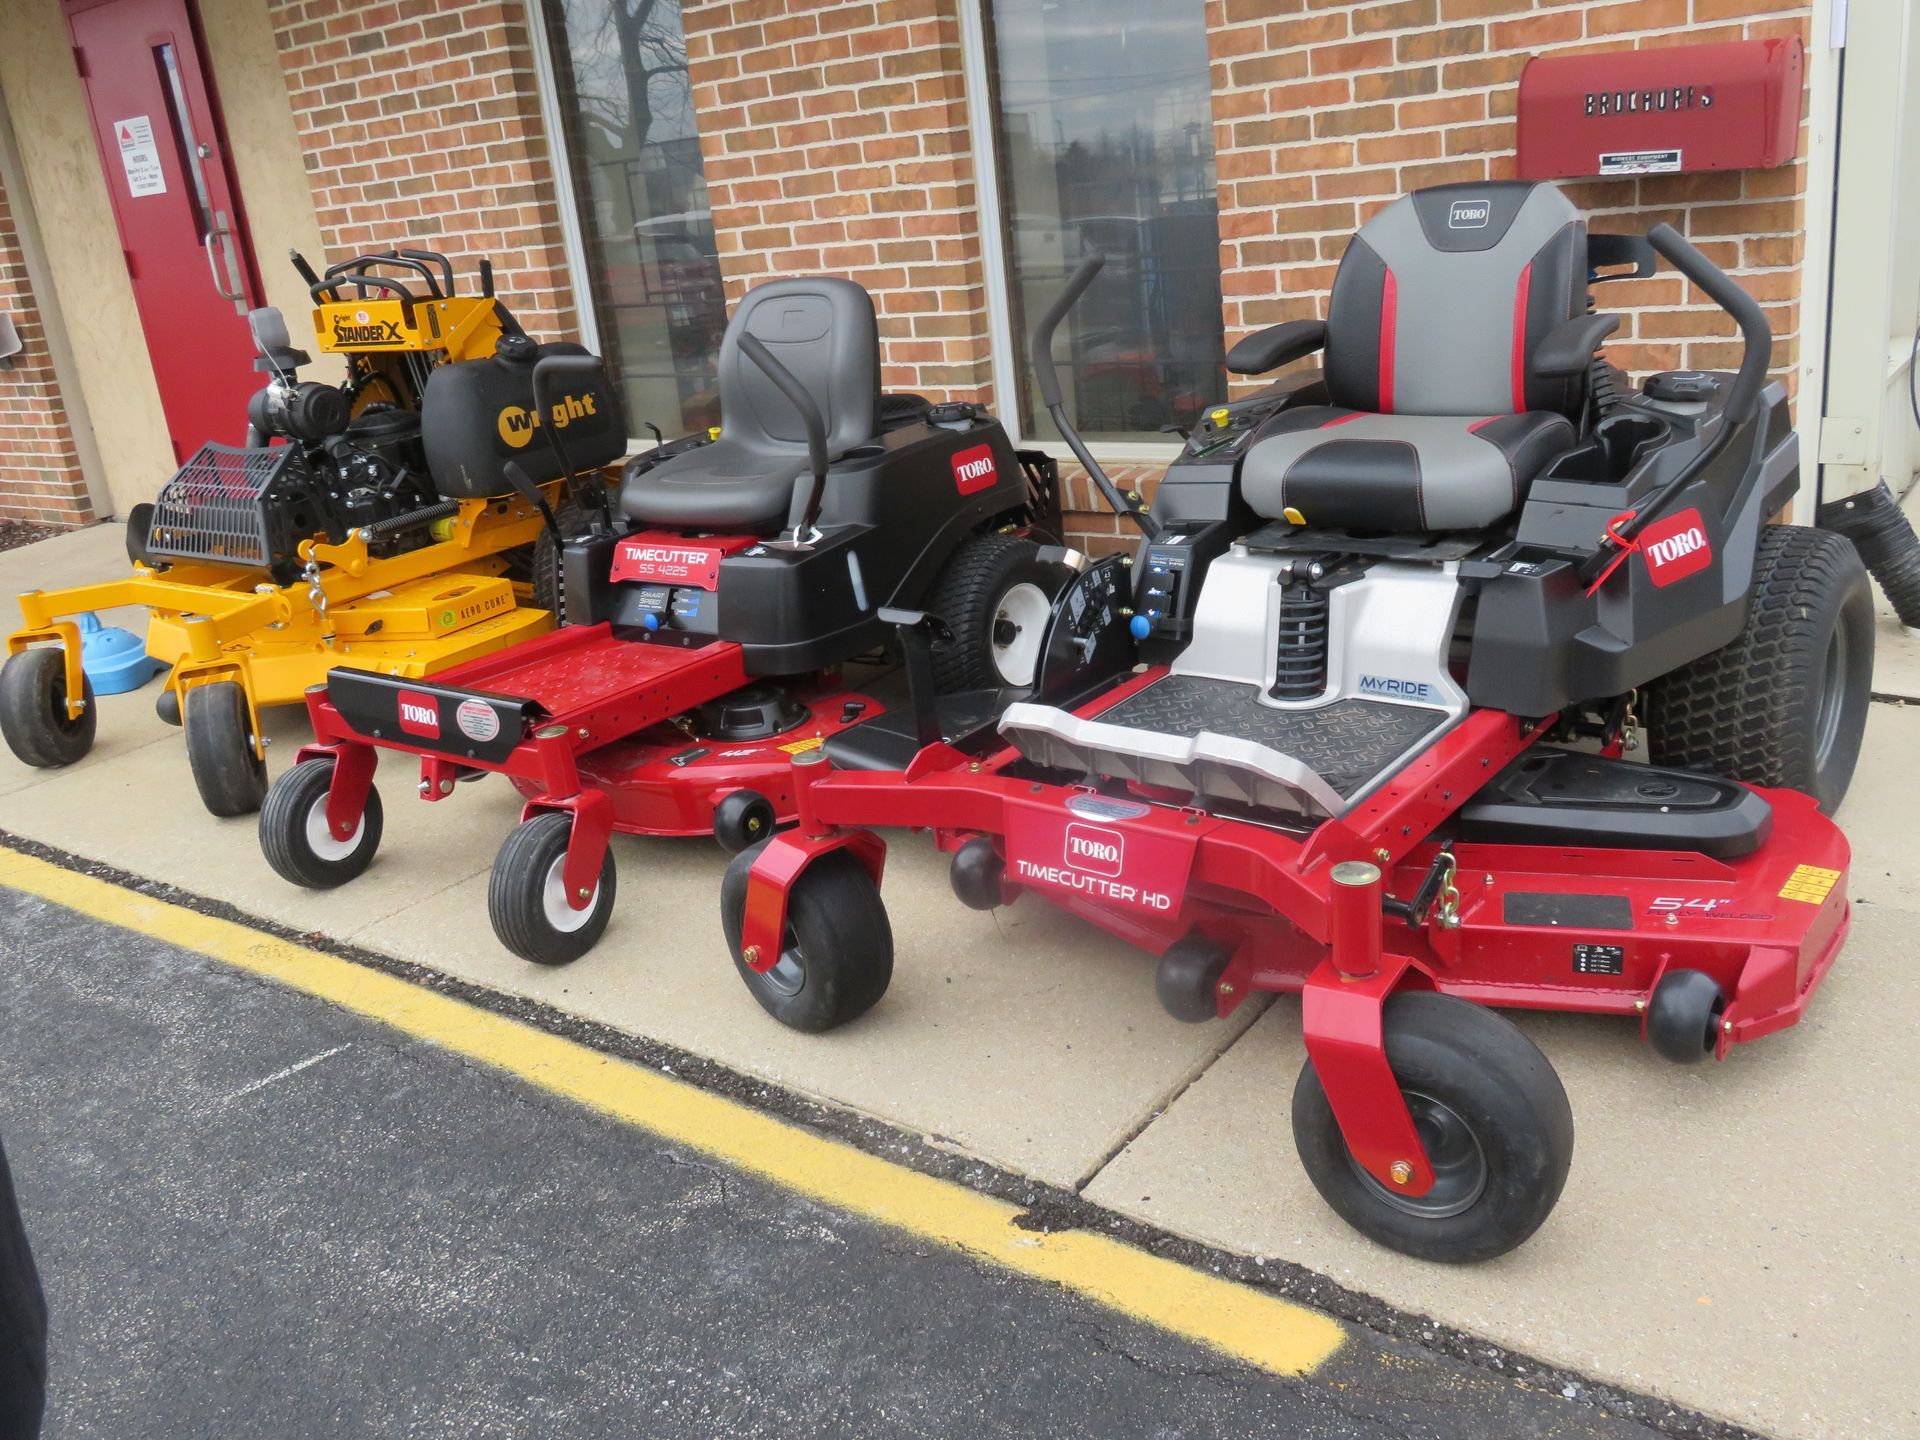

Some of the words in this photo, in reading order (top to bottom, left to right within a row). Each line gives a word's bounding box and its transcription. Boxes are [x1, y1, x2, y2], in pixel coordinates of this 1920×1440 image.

[1453, 208, 1486, 220] TORO
[333, 323, 385, 342] STANDER
[957, 457, 992, 482] TORO
[625, 547, 711, 565] TIMECUTTER
[1647, 527, 1703, 568] TORO
[639, 563, 656, 575] SS
[658, 564, 689, 577] 4225
[639, 597, 661, 606] SPEED
[640, 590, 665, 599] SMART
[460, 604, 482, 620] AERO
[484, 595, 505, 611] CORE
[401, 703, 437, 727] TORO
[1070, 837, 1118, 863] TORO
[1017, 860, 1136, 902] TIMECUTTER
[1142, 889, 1171, 911] HD
